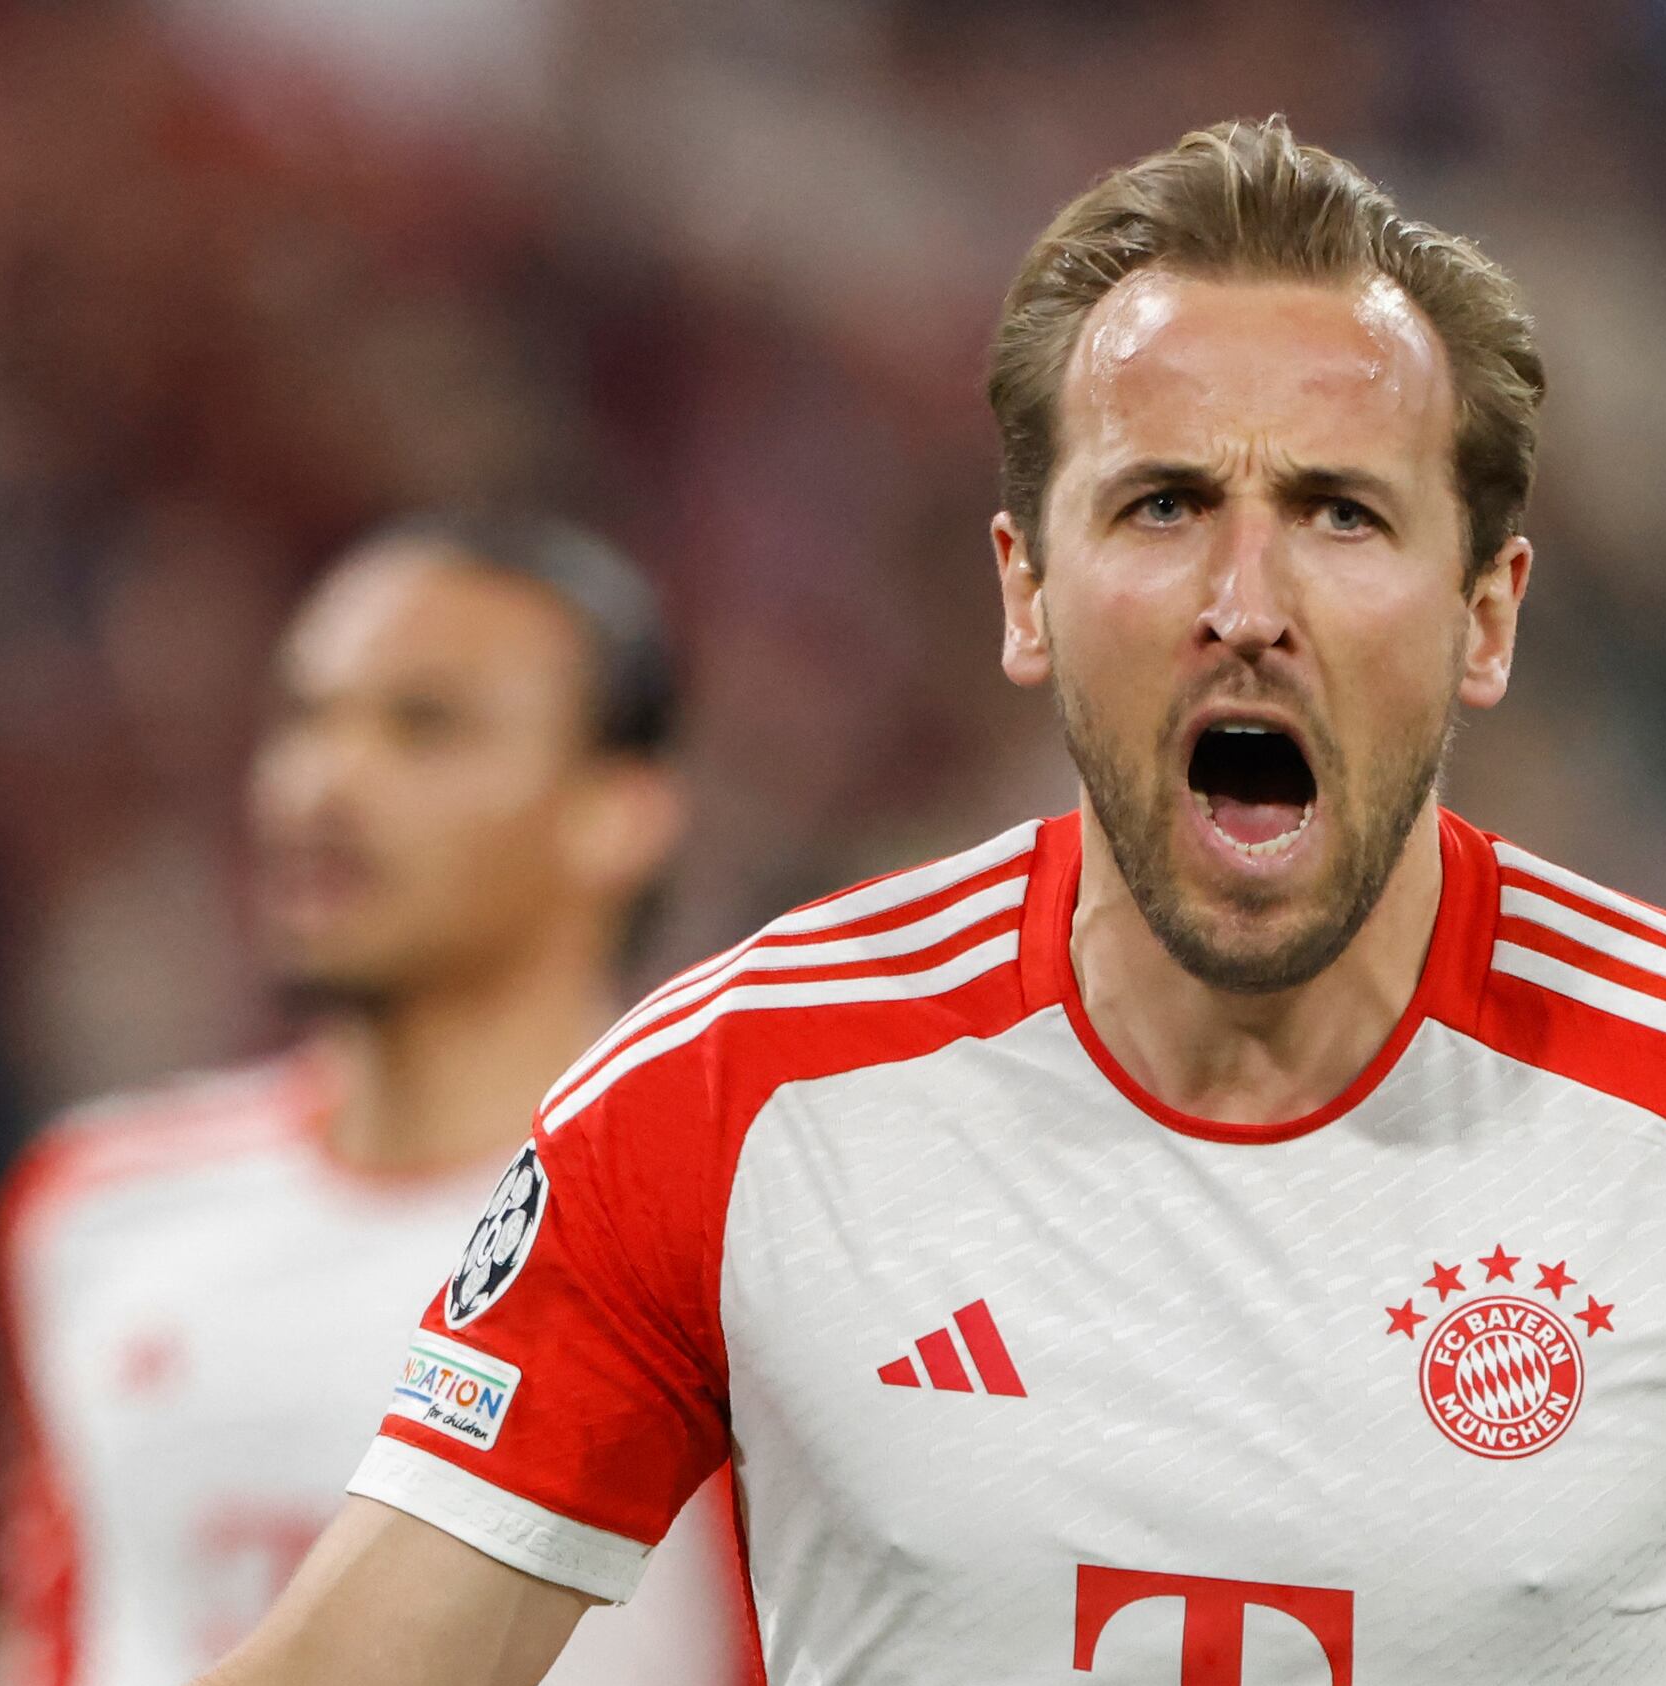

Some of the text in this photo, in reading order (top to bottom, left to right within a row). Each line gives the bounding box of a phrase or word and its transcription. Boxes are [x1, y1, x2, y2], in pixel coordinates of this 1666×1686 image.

[1433, 1306, 1571, 1367] FC BAYERN
[422, 1402, 489, 1442] for children
[1436, 1391, 1572, 1449] MÜNCHEN
